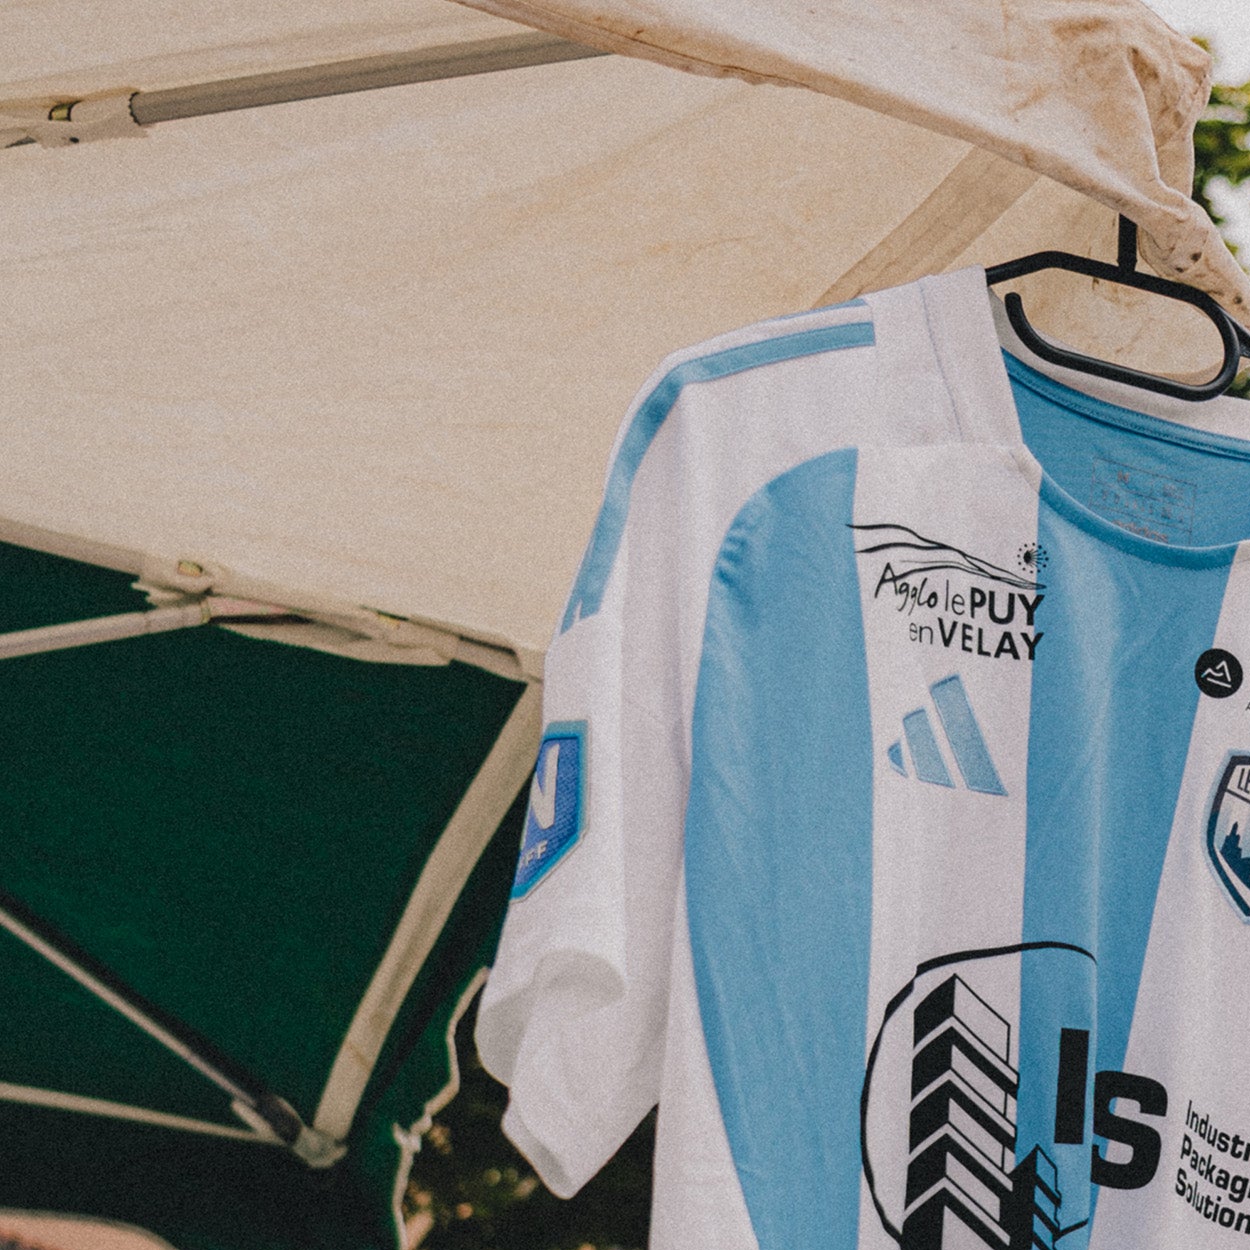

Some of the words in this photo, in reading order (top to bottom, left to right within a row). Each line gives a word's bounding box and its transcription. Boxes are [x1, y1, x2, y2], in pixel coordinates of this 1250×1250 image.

[874, 562, 938, 616] Agglo
[908, 621, 934, 645] en
[937, 617, 1045, 661] VELAY
